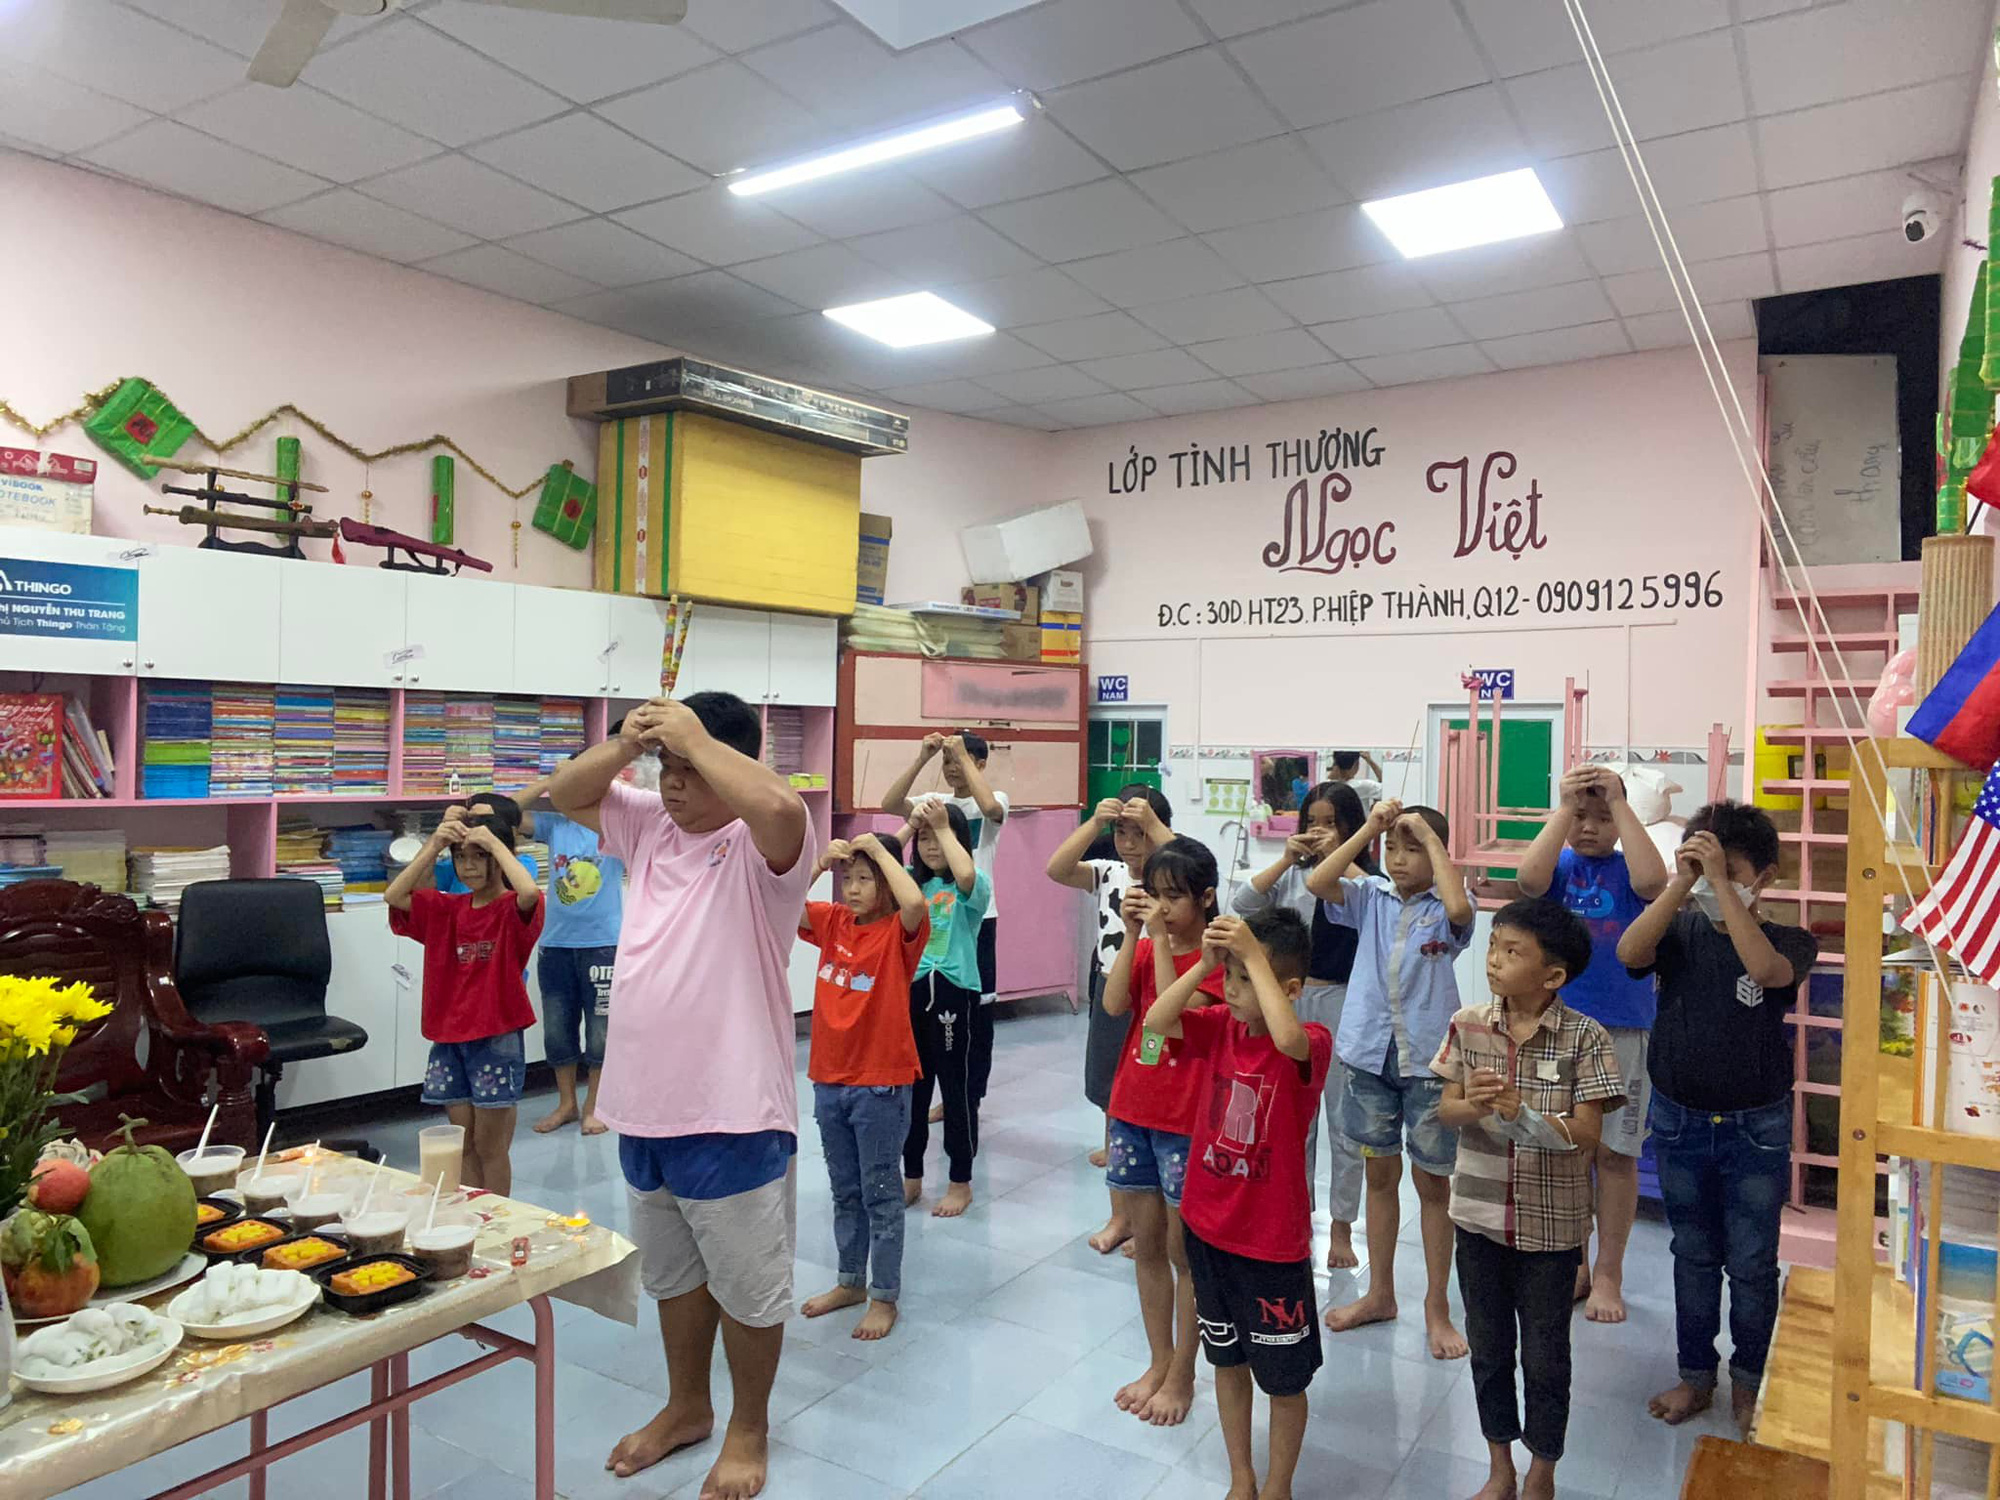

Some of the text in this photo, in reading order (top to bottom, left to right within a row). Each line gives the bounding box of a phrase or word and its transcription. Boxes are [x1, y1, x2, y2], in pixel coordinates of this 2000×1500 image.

[1108, 445, 1157, 494] LỚP
[1262, 451, 1548, 574] Ngọc Việt
[14, 580, 72, 595] THINGO
[12, 602, 60, 616] NGUYỄN
[63, 607, 85, 617] THU
[88, 609, 125, 619] TRANG
[36, 618, 73, 630] Thingo
[1100, 677, 1126, 690] WC
[1475, 671, 1511, 687] WC
[1102, 691, 1125, 700] NAM
